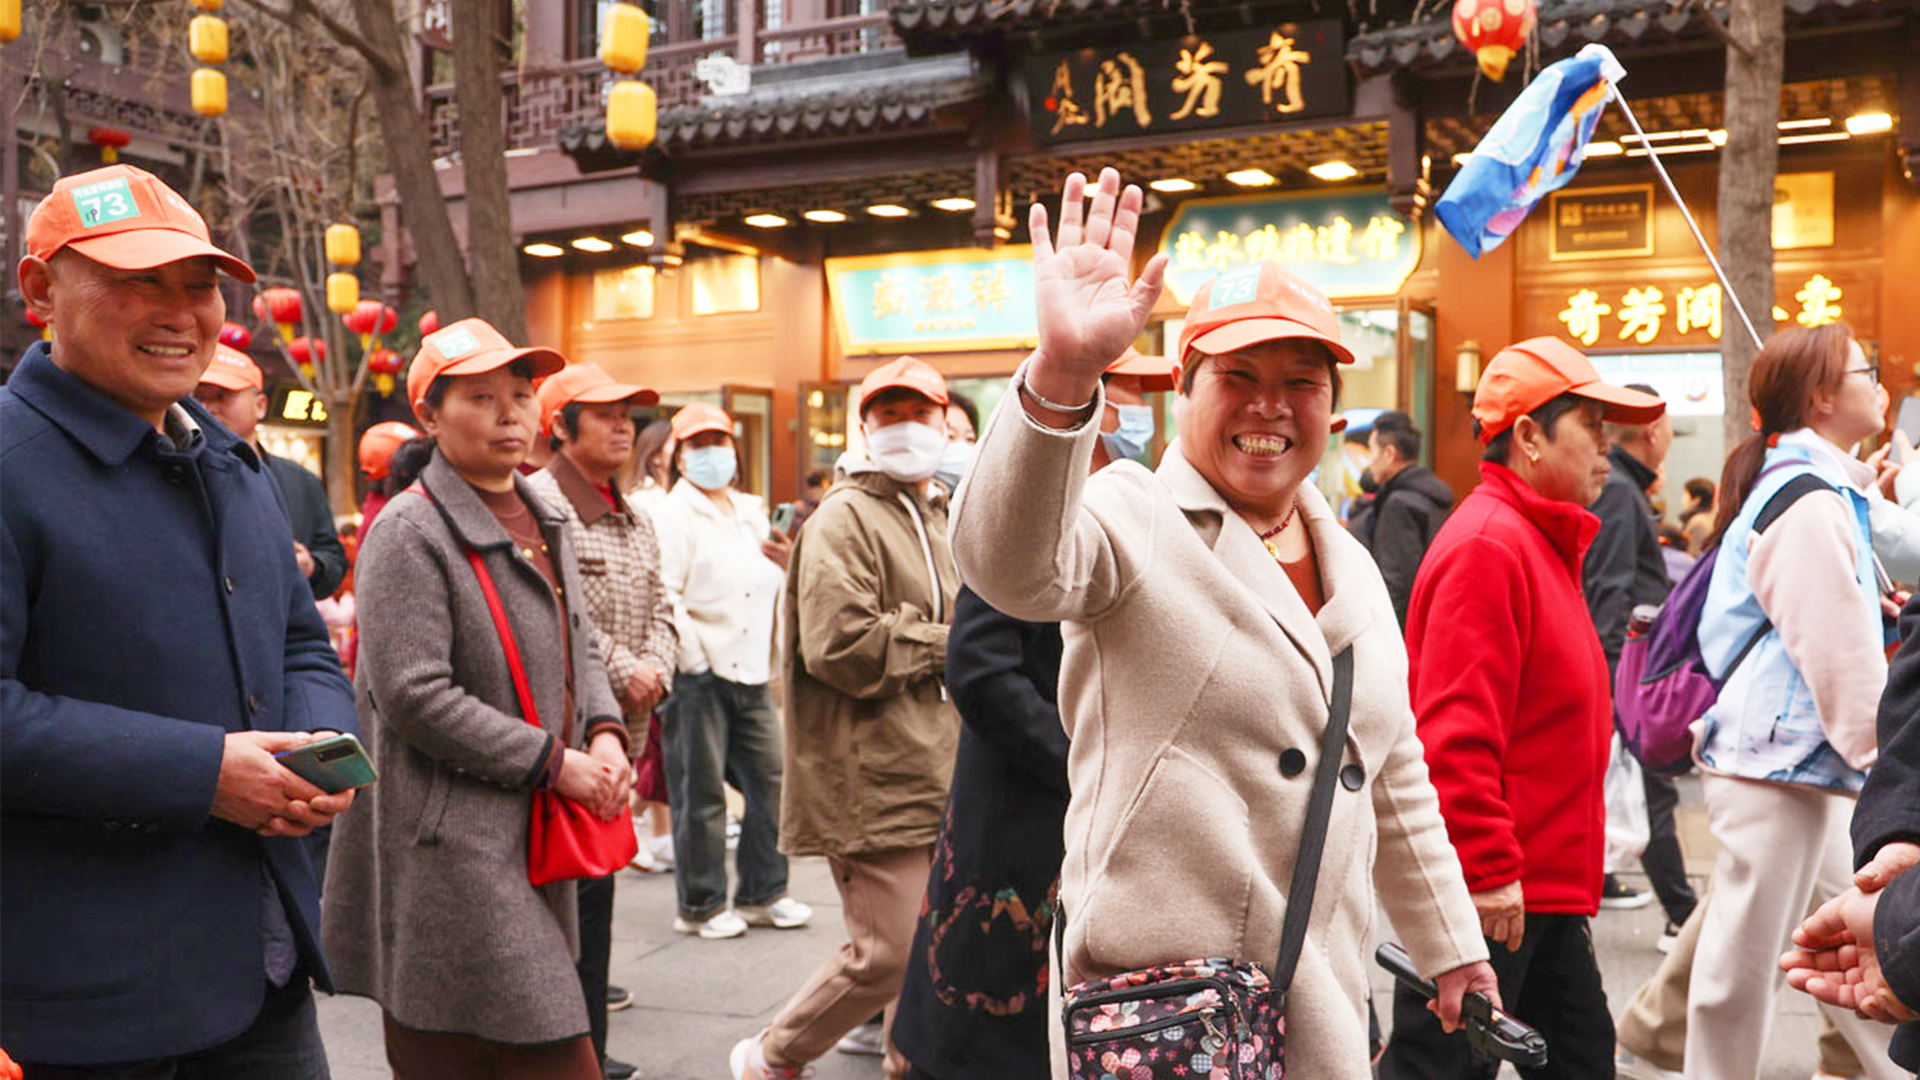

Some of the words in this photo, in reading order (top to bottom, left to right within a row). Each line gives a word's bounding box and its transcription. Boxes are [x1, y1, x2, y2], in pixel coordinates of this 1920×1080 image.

[81, 192, 129, 221] 73
[1219, 278, 1253, 303] 73
[1558, 274, 1843, 347] 奇芳阁卖
